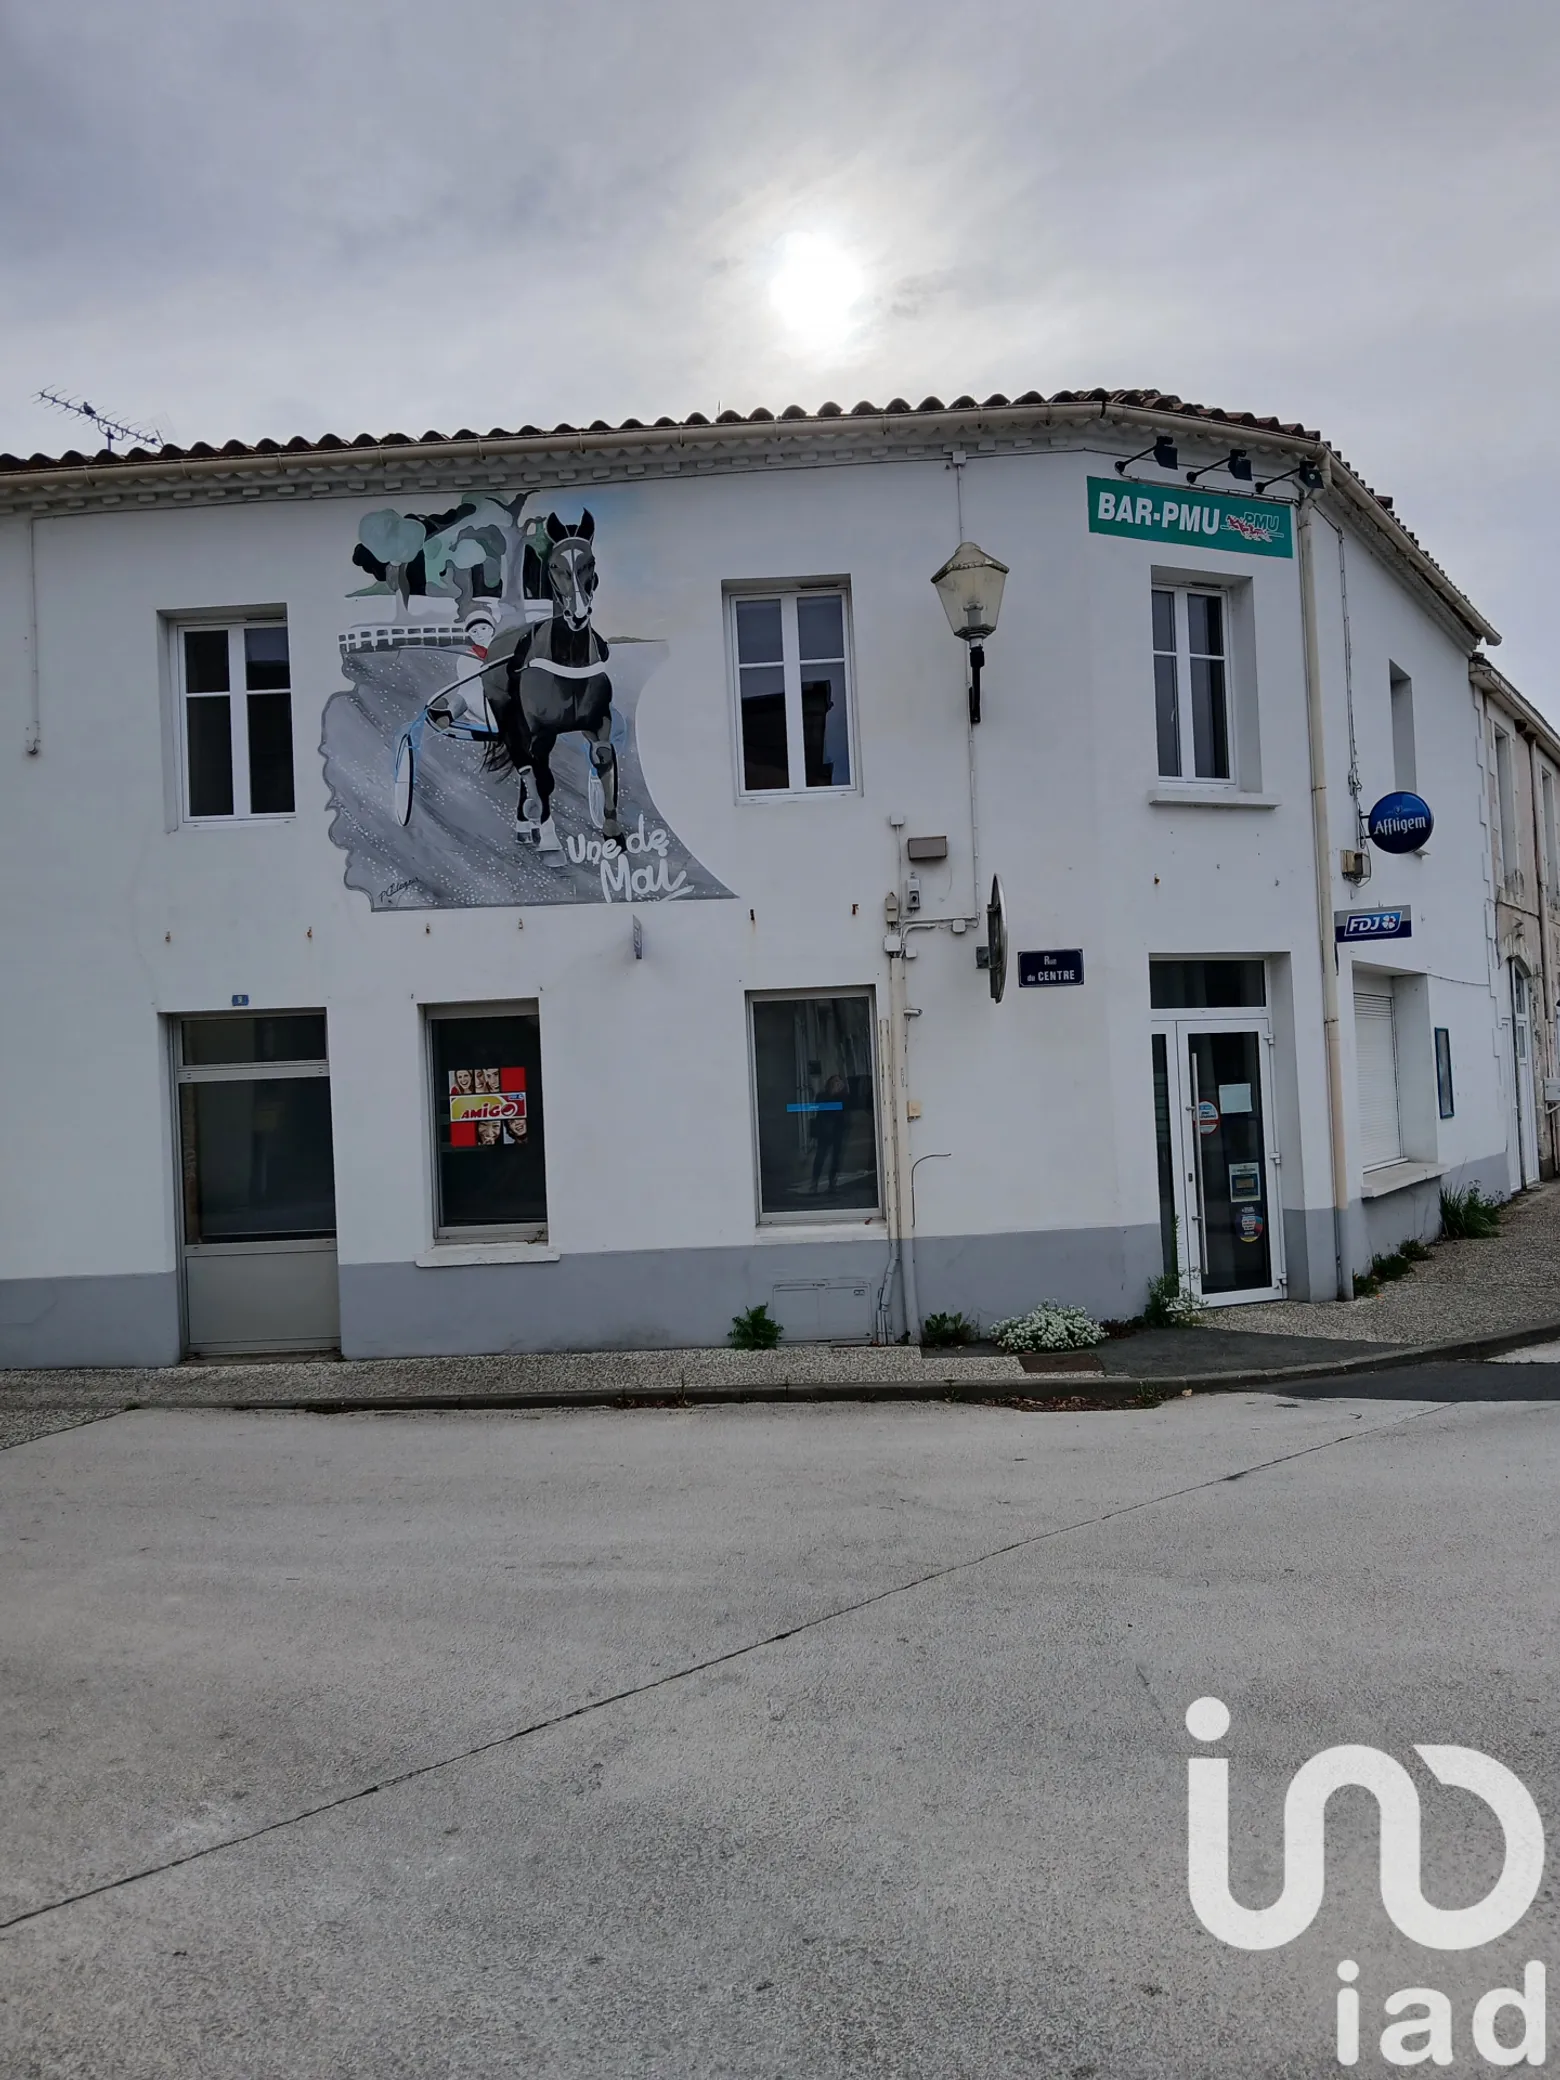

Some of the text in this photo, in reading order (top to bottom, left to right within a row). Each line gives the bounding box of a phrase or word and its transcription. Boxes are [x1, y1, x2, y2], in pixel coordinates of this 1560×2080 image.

[1097, 491, 1220, 536] BAR-PMU
[1244, 511, 1279, 532] PMU
[1373, 816, 1427, 836] Affligem
[566, 813, 670, 865] Une de
[600, 849, 692, 904] Mai
[1349, 914, 1380, 932] FDJ
[1037, 970, 1075, 982] CENTRE
